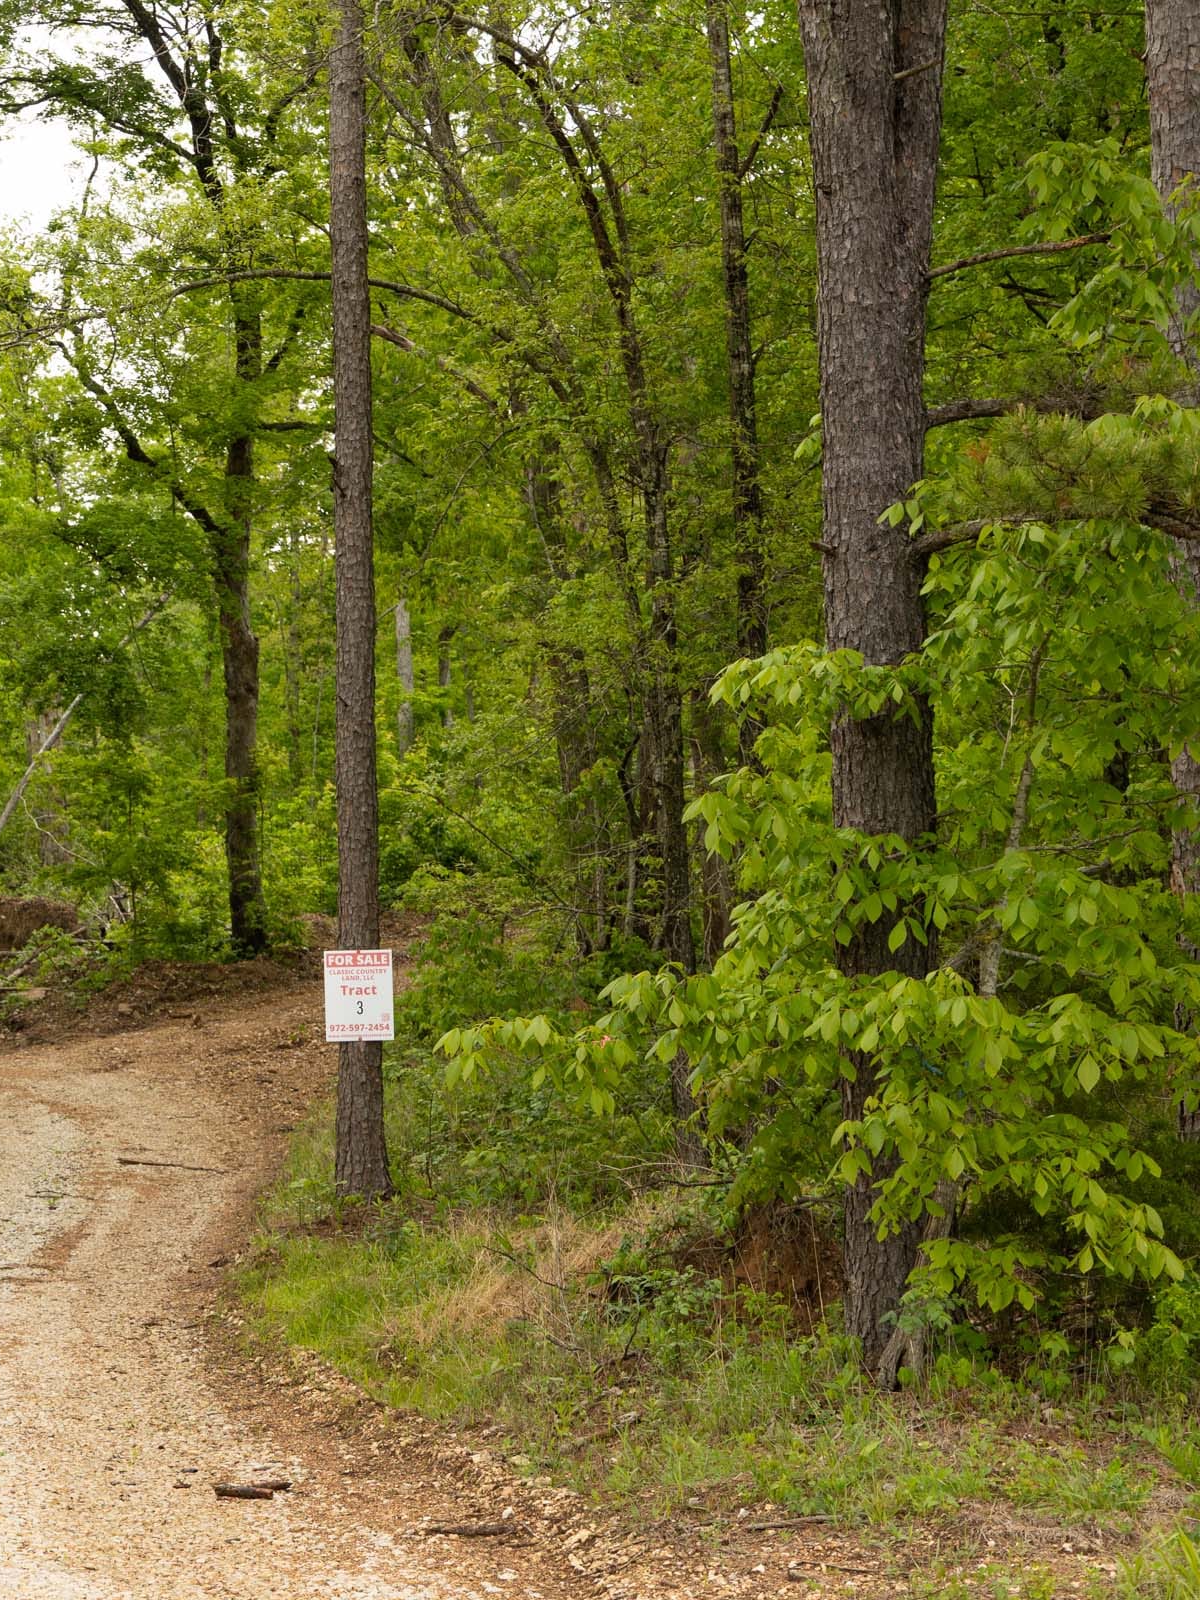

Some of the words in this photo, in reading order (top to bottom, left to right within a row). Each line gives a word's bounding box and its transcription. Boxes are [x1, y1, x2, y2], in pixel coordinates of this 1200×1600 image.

[327, 955, 353, 966] FOR
[356, 954, 388, 965] SALE
[340, 985, 377, 996] Tract
[356, 1000, 364, 1015] 3
[329, 1024, 390, 1032] 972-597-2454
